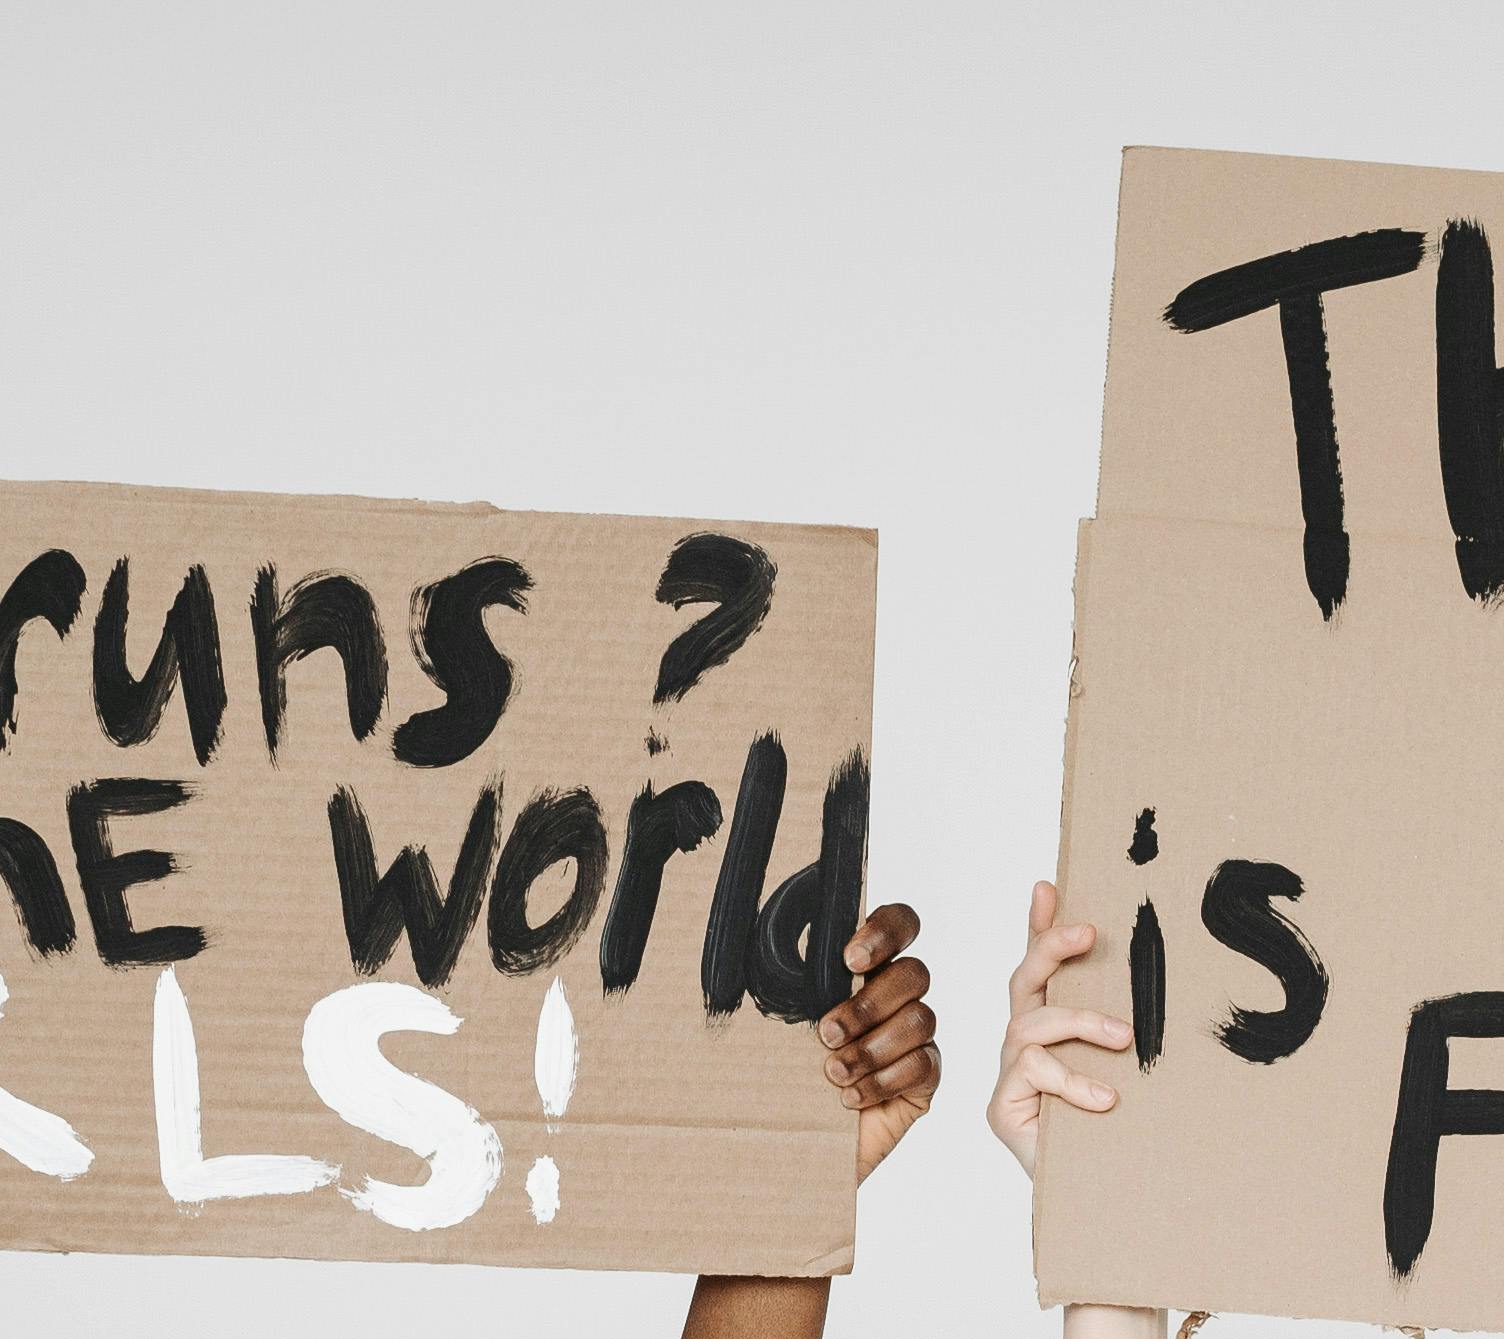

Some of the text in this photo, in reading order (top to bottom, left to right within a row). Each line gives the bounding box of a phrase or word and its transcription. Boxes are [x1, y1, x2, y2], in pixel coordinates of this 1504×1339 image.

[644, 532, 787, 760] ?
[328, 728, 872, 1030] world
[1128, 805, 1331, 1075] is
